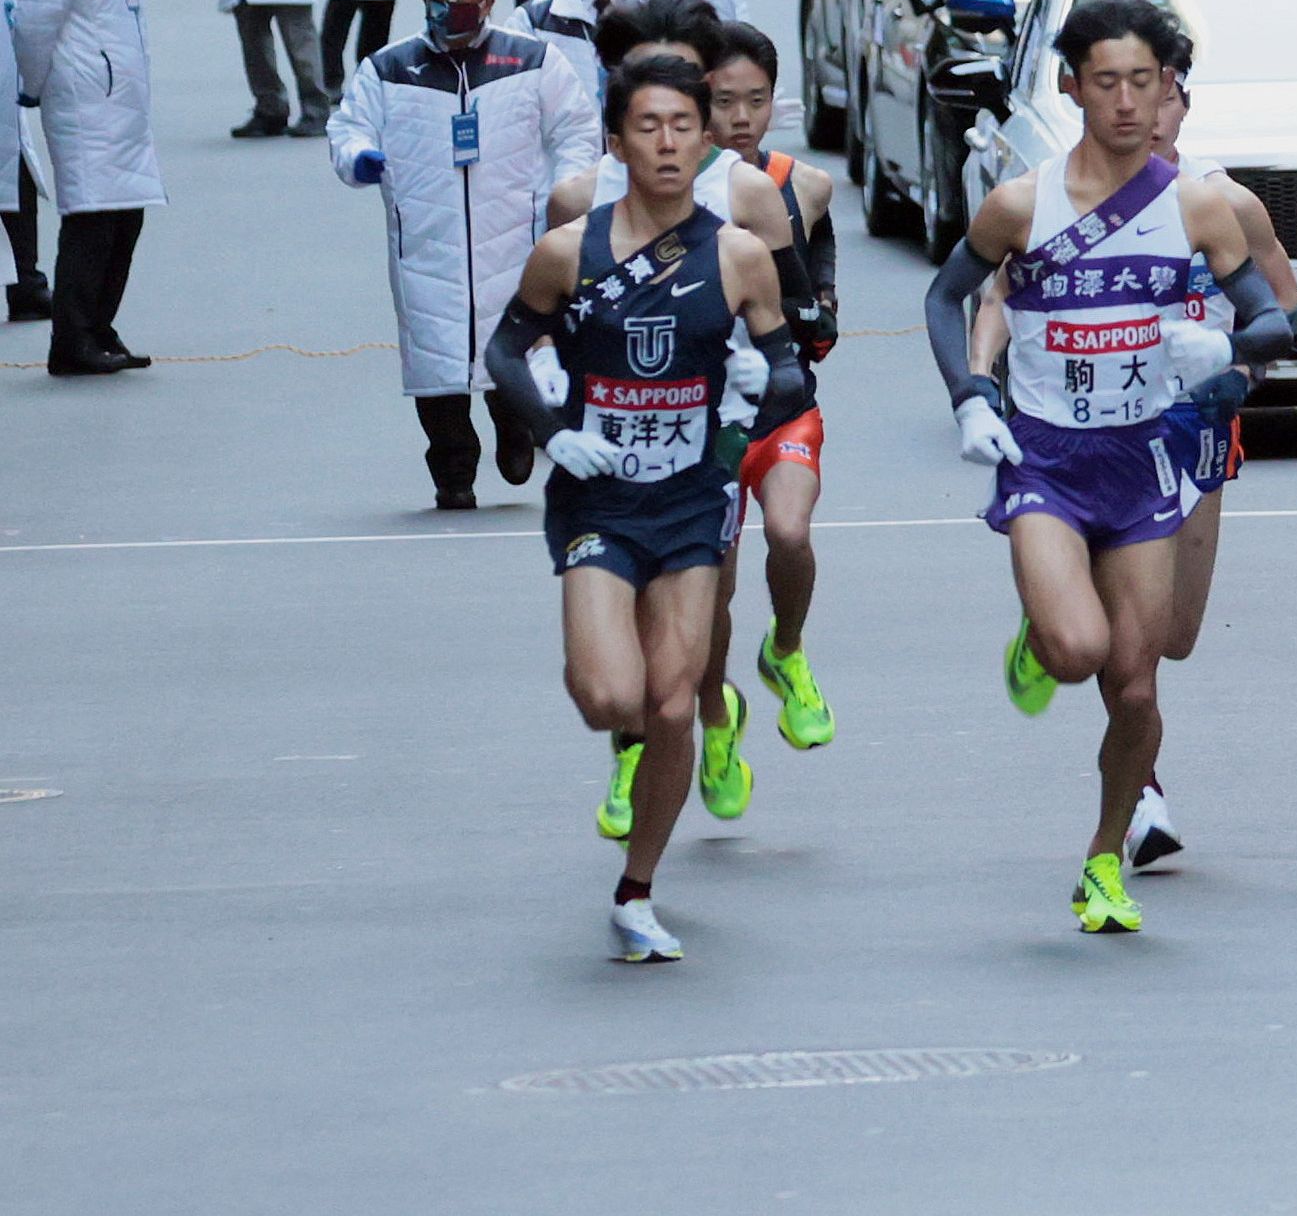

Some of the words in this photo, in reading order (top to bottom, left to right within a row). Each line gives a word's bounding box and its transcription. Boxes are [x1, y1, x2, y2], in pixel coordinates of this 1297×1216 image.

[1072, 322, 1160, 349] SAPPORO
[612, 384, 705, 405] SAPPORO
[1073, 397, 1145, 423] 8-15
[597, 413, 692, 448] 東洋大
